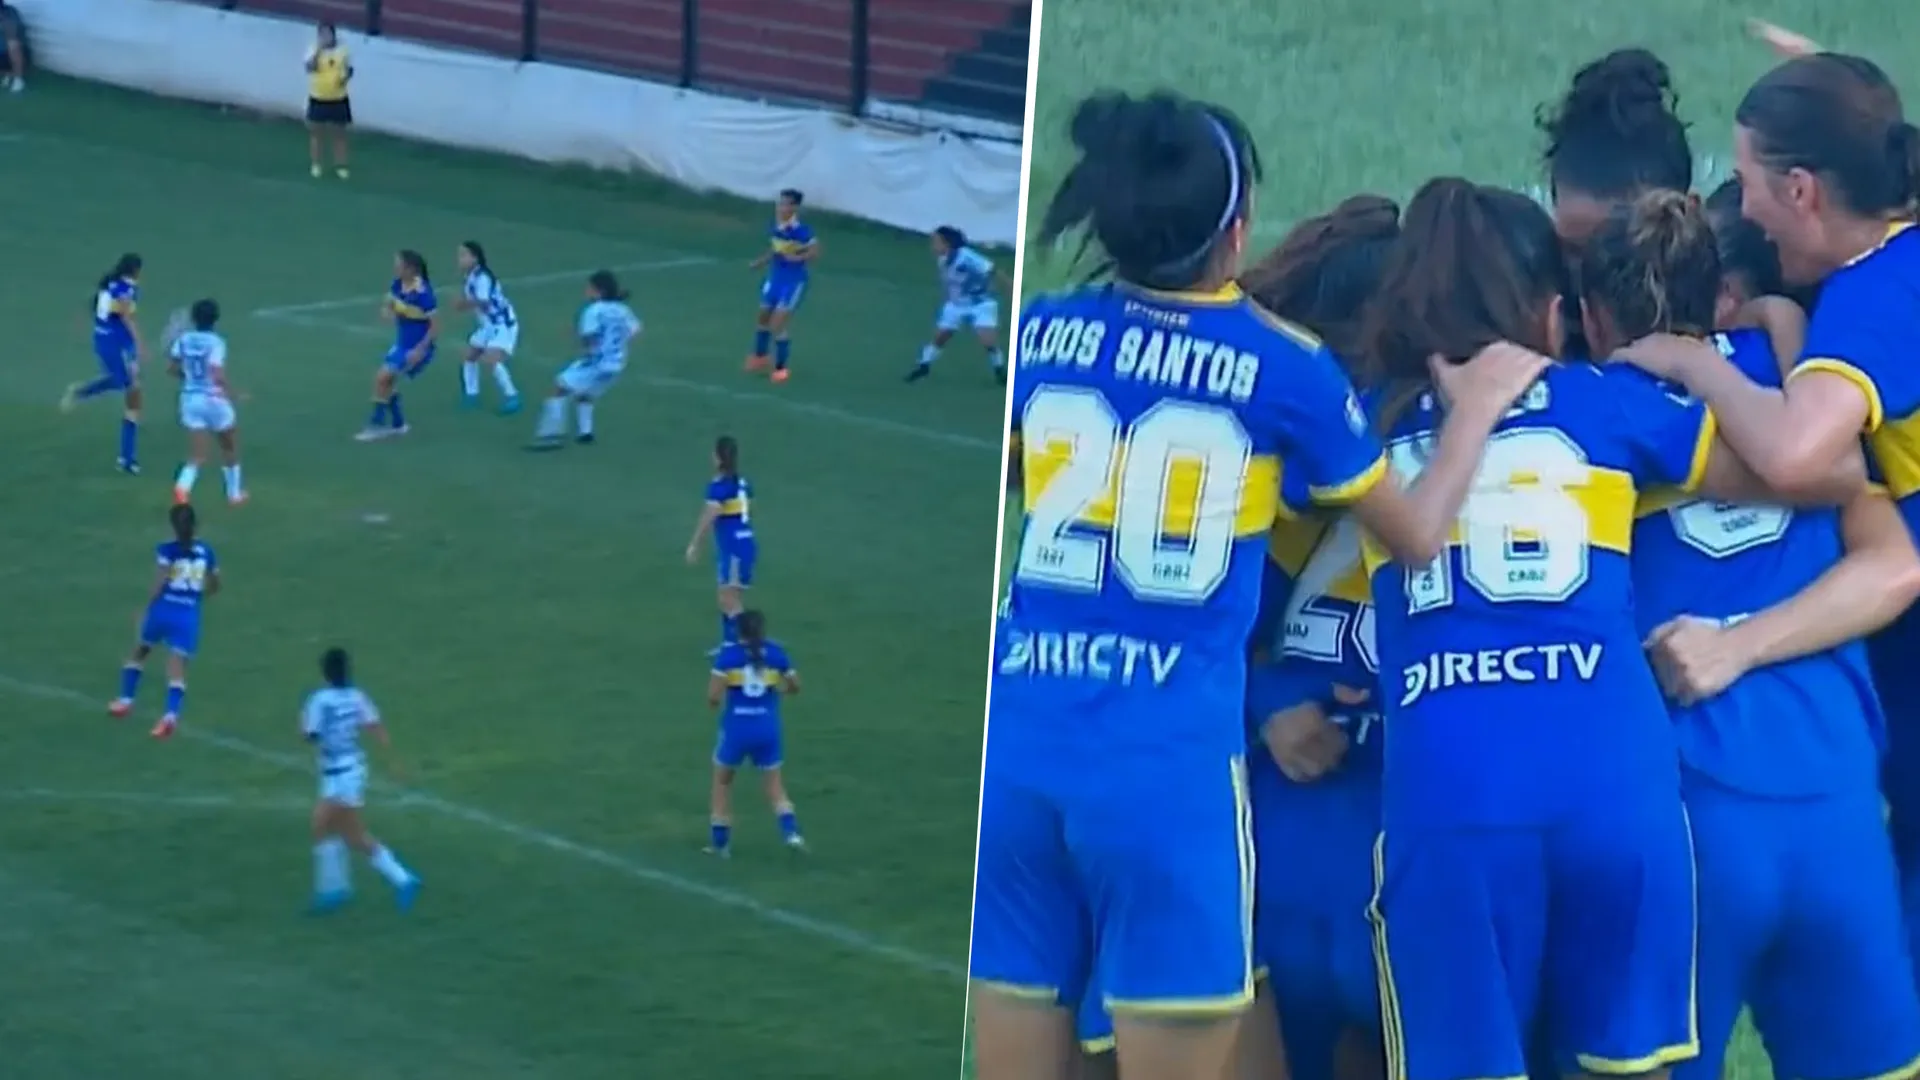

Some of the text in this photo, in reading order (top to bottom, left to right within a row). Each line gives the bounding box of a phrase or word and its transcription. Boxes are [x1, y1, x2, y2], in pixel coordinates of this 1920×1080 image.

[1115, 325, 1260, 402] SANTOS
[1016, 382, 1254, 606] 20
[1000, 628, 1183, 688] DIRECTV
[1400, 642, 1603, 707] DIRECTV
